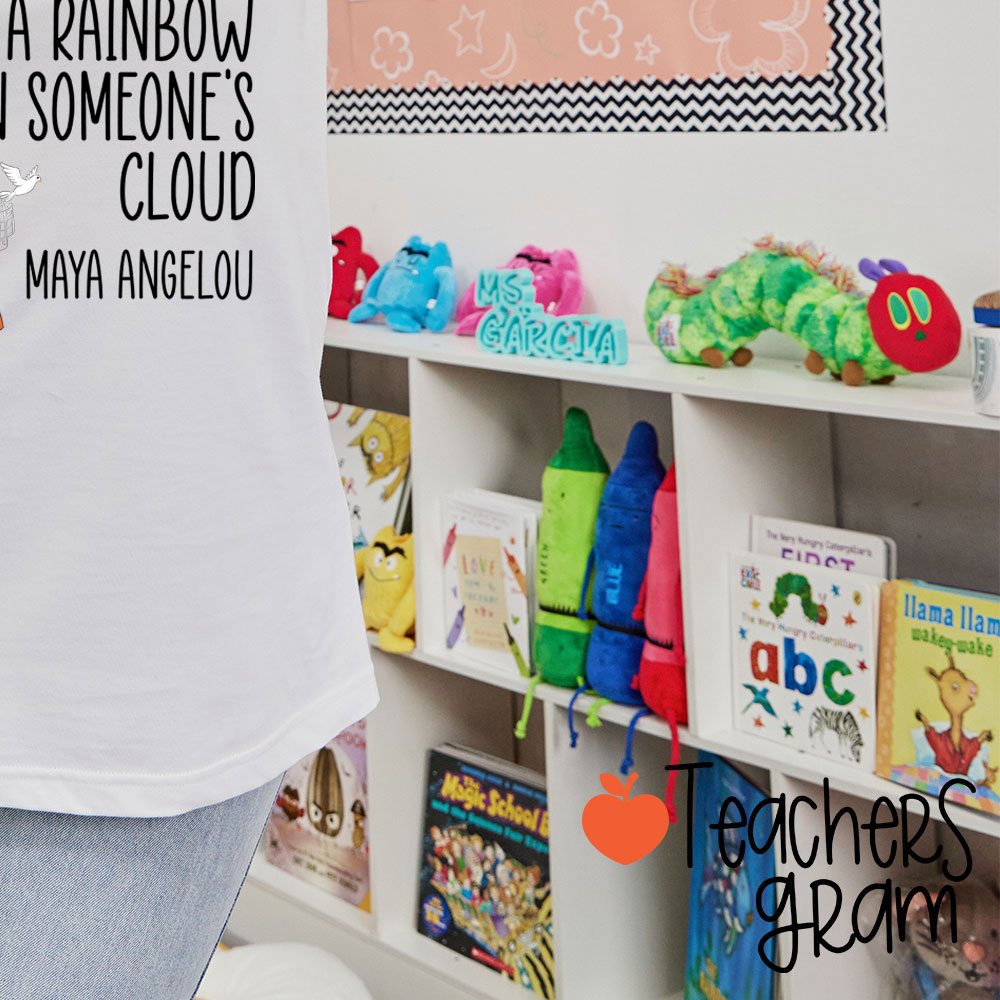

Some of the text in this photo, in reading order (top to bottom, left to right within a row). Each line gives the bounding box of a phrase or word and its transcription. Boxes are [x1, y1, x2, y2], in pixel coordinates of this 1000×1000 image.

[28, 68, 255, 142] SOMEONE'S
[119, 151, 257, 222] CLOUD
[25, 248, 254, 300] MAYA ANGELOU
[477, 270, 524, 305] MS
[479, 312, 620, 364] GARCIA
[905, 593, 953, 627] llama
[750, 636, 855, 706] abc
[441, 771, 487, 811] Magic
[487, 788, 541, 833] School
